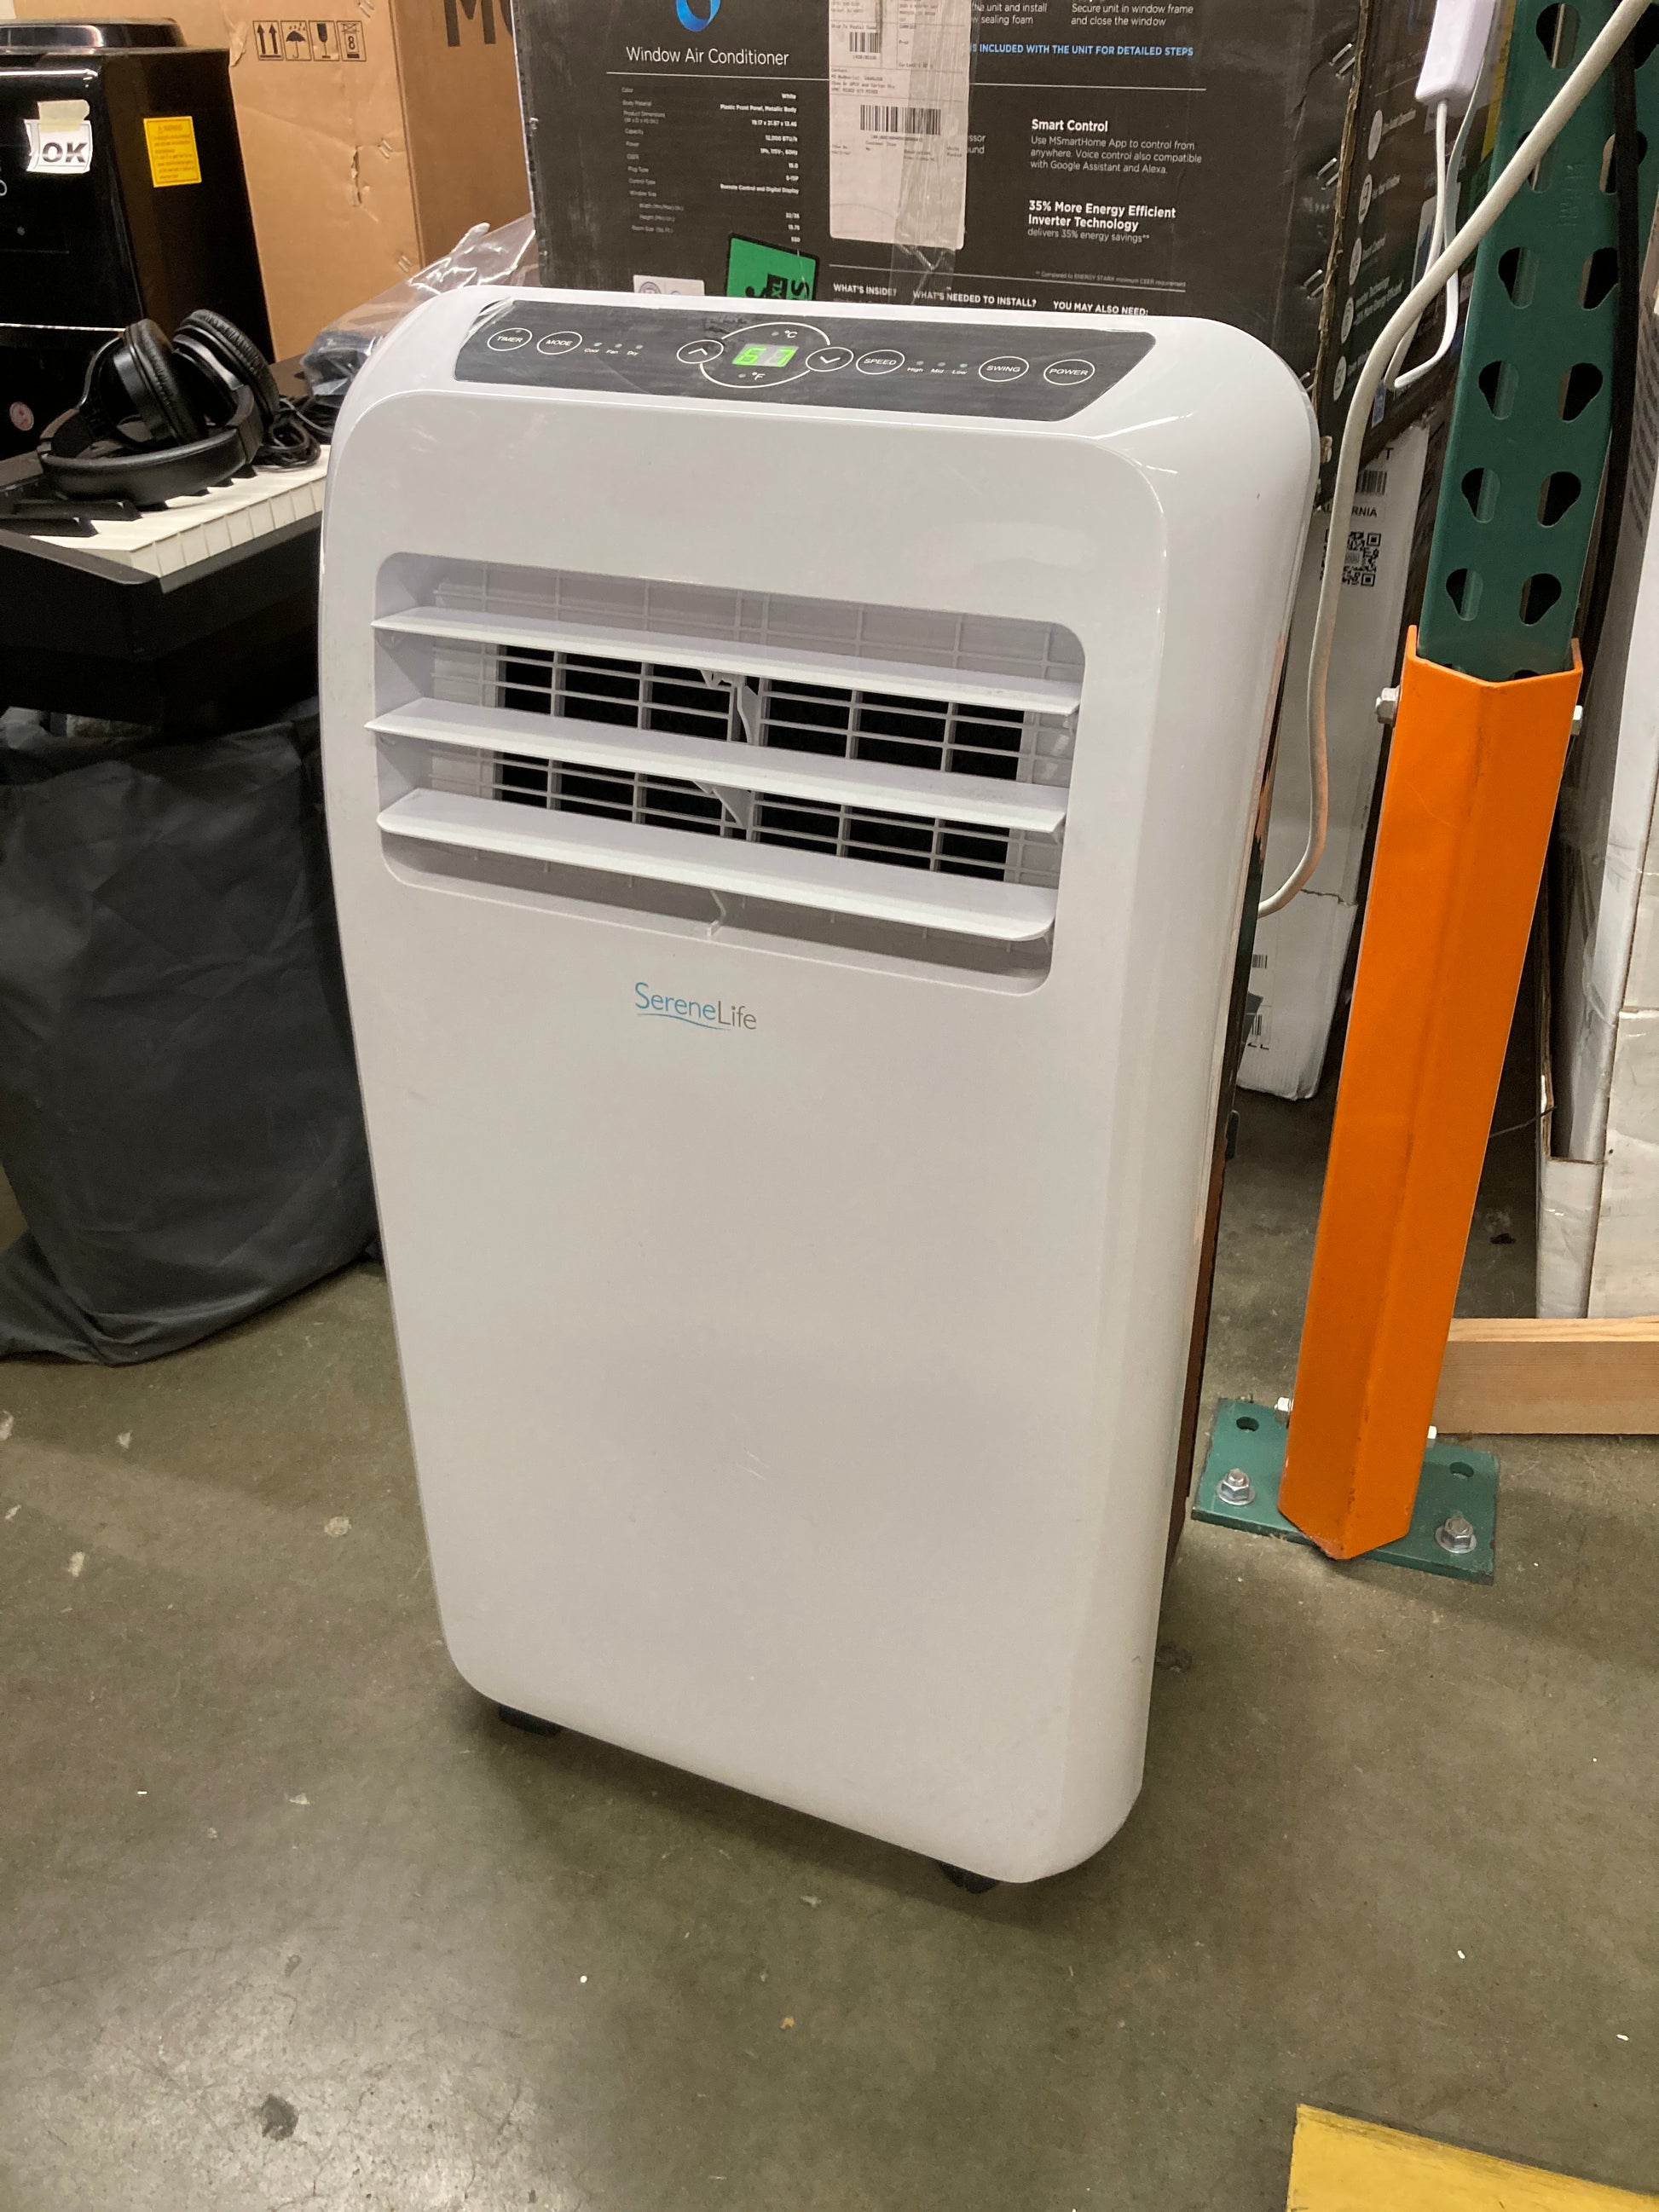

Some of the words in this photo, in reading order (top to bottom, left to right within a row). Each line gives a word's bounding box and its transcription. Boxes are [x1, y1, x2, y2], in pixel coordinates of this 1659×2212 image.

[986, 3, 1002, 12] unit
[1004, 3, 1020, 12] and
[1023, 3, 1047, 12] install
[1072, 3, 1101, 14] Secure
[1103, 4, 1119, 13] unit
[1121, 4, 1129, 13] in
[1131, 4, 1165, 14] window
[1167, 4, 1194, 14] frame
[981, 14, 1009, 26] sealing
[1012, 15, 1033, 25] foam
[1071, 16, 1087, 26] and
[1090, 16, 1112, 26] close
[1114, 17, 1129, 26] the
[1131, 17, 1166, 26] window
[626, 46, 680, 62] Window
[685, 47, 704, 63] Air
[708, 48, 789, 66] Conditioner
[980, 44, 1023, 54] INCLUDED
[1026, 44, 1049, 54] WITH
[1052, 45, 1069, 55] THE
[1072, 45, 1093, 55] UNIT
[1095, 46, 1114, 55] FOR
[1117, 46, 1162, 55] DETAILED
[1165, 47, 1194, 56] STEPS
[1032, 118, 1064, 130] Smart
[1066, 120, 1108, 132] Control
[1031, 136, 1046, 145] Use
[1049, 136, 1107, 147] MSmartHome
[1109, 138, 1127, 149] App
[1130, 139, 1138, 148] to
[1141, 140, 1171, 150] control
[1174, 141, 1194, 150] from
[43, 141, 88, 163] OK
[1031, 148, 1072, 159] anywhere.
[1076, 149, 1099, 159] Voice
[1101, 150, 1132, 160] control
[1134, 152, 1151, 161] also
[1153, 153, 1202, 164] compatible
[1031, 159, 1048, 169] with
[1050, 160, 1080, 171] Google
[1083, 162, 1120, 172] Assistant
[1123, 164, 1139, 172] and
[1142, 165, 1168, 174] Alexa.
[1029, 200, 1051, 211] 35%
[1055, 201, 1082, 213] More
[1085, 203, 1125, 217] Energy
[1128, 205, 1176, 218] Efficient
[1029, 214, 1071, 227] Inverter
[1074, 217, 1139, 232] Technology
[1027, 228, 1059, 238] delivers
[1061, 228, 1078, 239] 35%
[1080, 231, 1108, 242] energy
[833, 283, 864, 293] WHAT'S
[866, 286, 897, 296] INSIDE?
[913, 289, 945, 301] WHAT'S
[946, 293, 980, 303] NEEDED
[983, 295, 995, 304] TO
[997, 297, 1037, 307] INSTALL?
[1054, 301, 1072, 310] YOU
[1074, 303, 1093, 313] MAY
[1095, 304, 1119, 315] ALSO
[734, 347, 797, 367] 67
[864, 357, 897, 366] SPEED
[635, 982, 757, 1031] SereneLife
